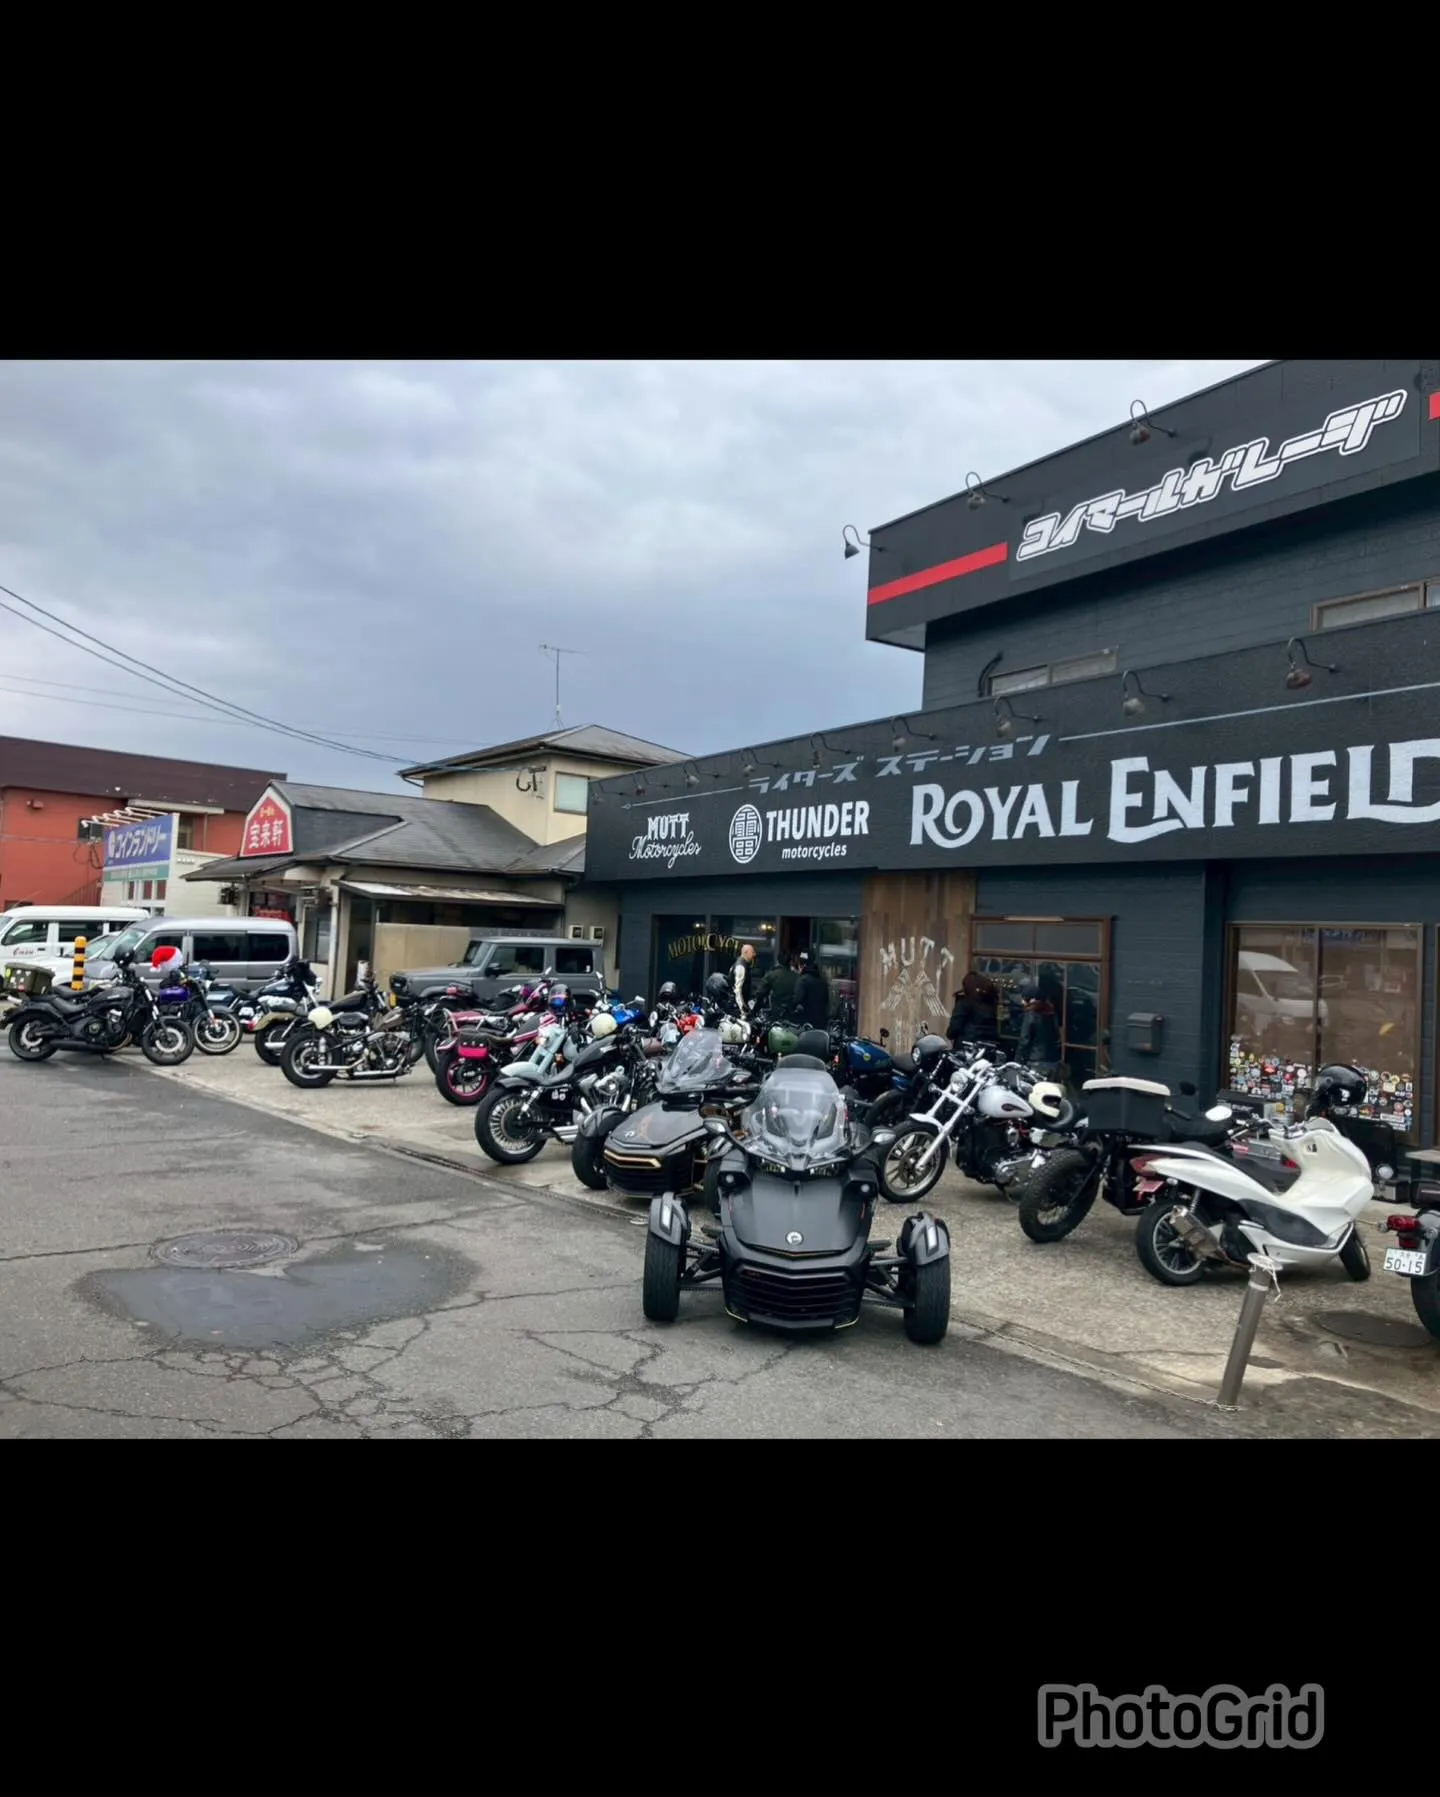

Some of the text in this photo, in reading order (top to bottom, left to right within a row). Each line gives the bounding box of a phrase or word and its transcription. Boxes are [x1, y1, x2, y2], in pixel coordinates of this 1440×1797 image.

[749, 734, 1050, 794] ライターズ ステーション
[647, 812, 690, 841] MUTT
[766, 800, 870, 842] THUNDER
[909, 780, 1094, 849] ROYAL
[629, 830, 702, 869] Motorcycles
[781, 842, 848, 861] motorcycles
[880, 936, 955, 985] MUTT
